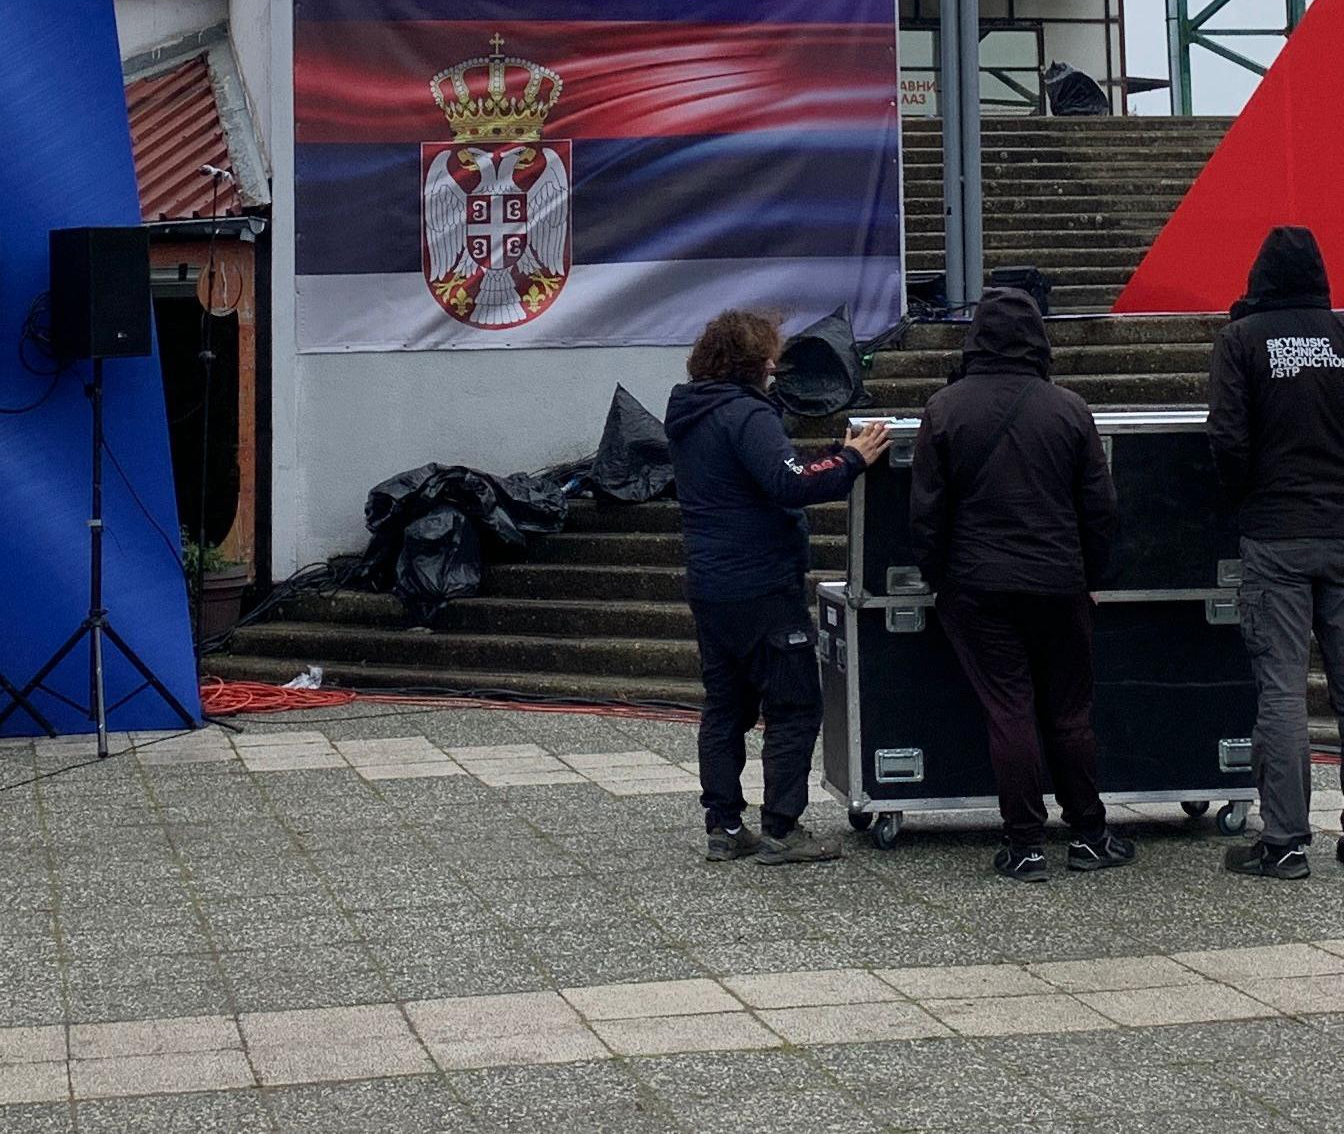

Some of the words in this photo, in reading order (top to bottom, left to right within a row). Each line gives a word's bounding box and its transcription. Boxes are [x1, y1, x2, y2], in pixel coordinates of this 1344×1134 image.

[900, 80, 938, 93] АВНИ
[901, 93, 927, 105] ЛАЗ
[1266, 337, 1330, 350] SKYMUSIC
[1268, 347, 1338, 359] TECHNICAL
[1271, 367, 1301, 379] /STP
